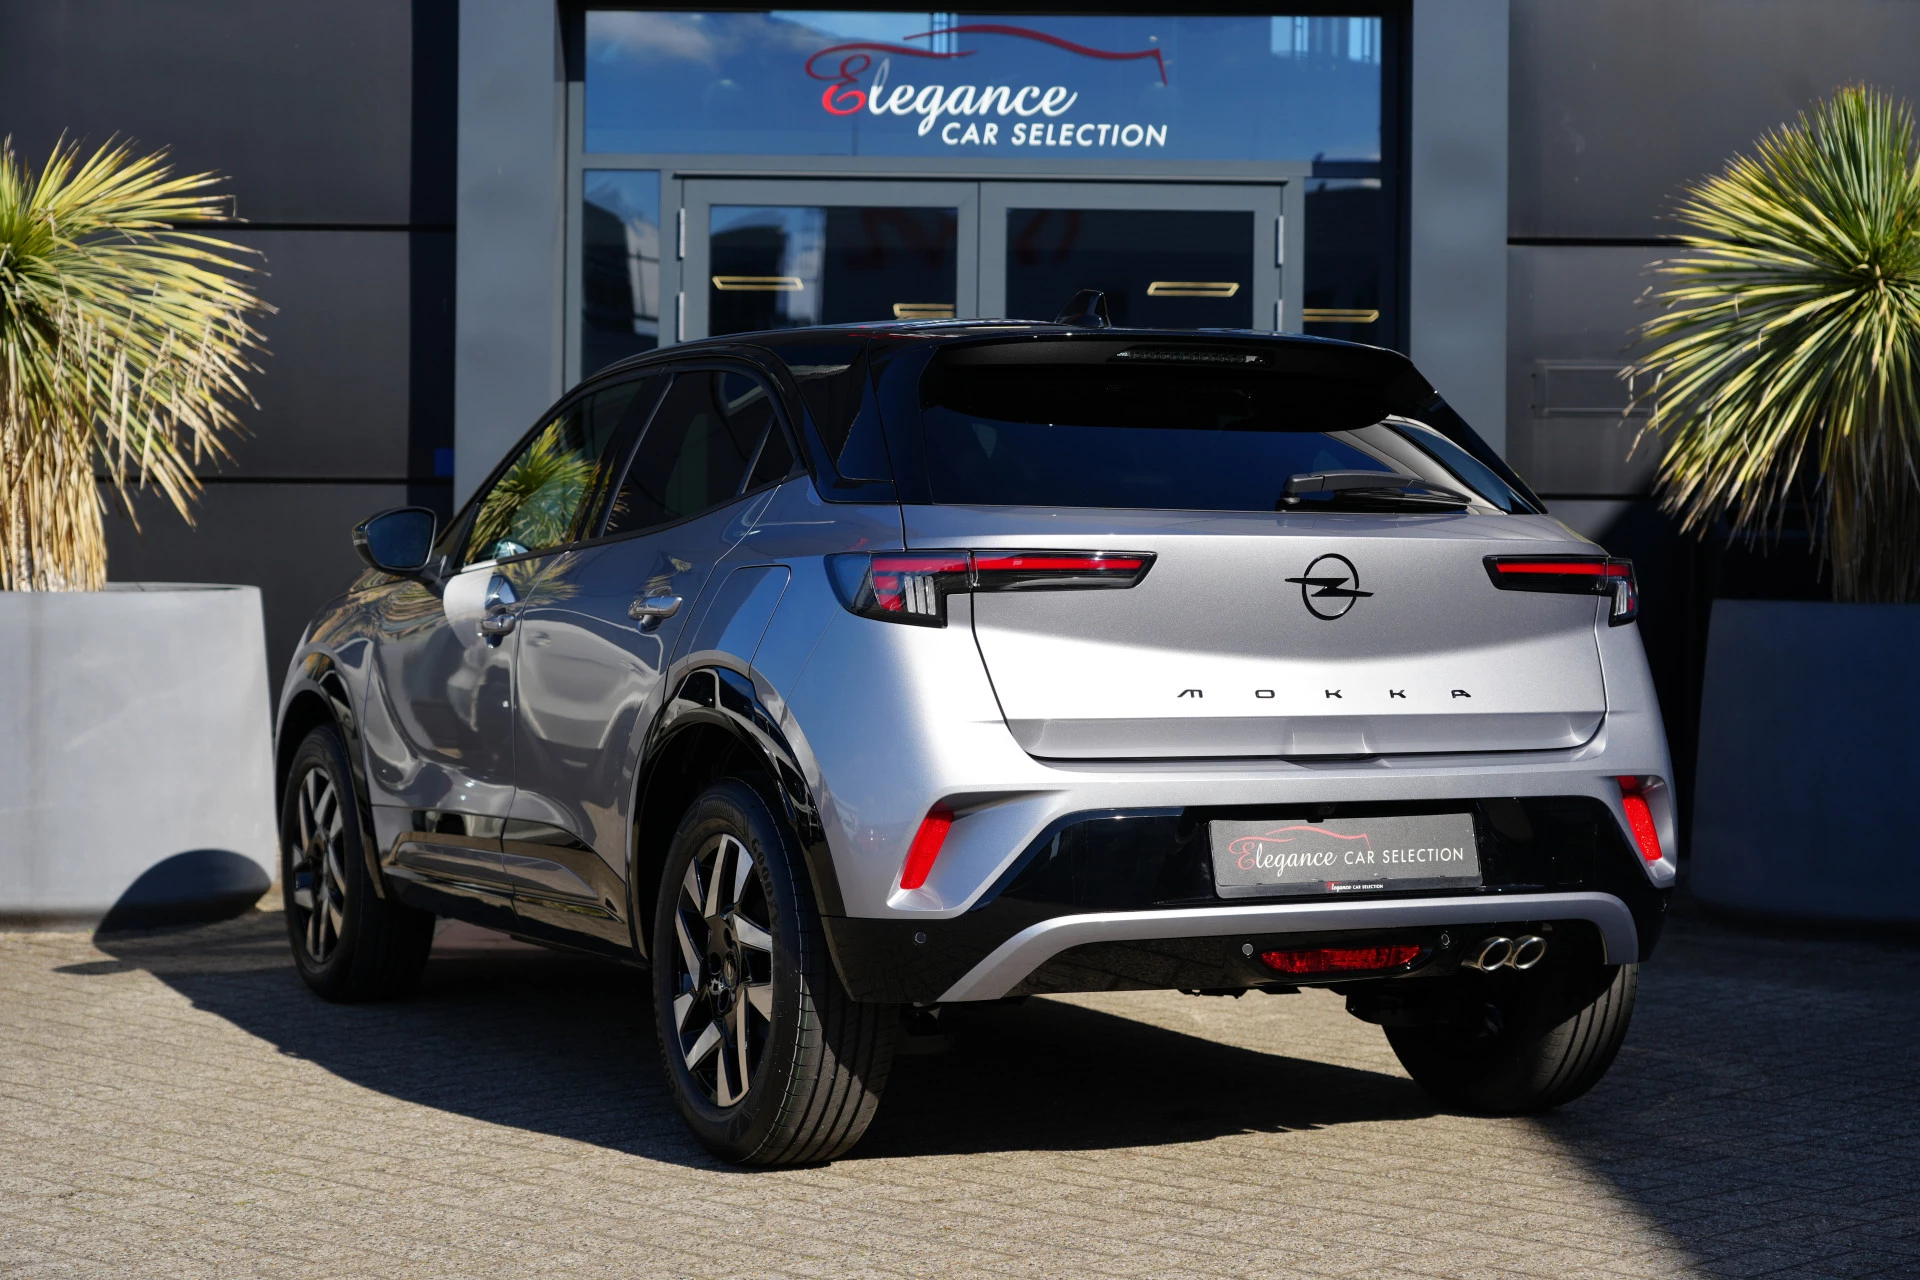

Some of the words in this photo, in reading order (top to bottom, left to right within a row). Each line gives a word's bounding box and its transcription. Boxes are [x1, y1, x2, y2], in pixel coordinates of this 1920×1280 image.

[806, 46, 1078, 136] Elegance
[941, 122, 999, 146] CAR
[1011, 123, 1168, 147] SELECTION
[1177, 688, 1471, 699] MOKKA
[1229, 837, 1337, 877] Elegance
[1344, 851, 1375, 865] CAR
[1382, 847, 1464, 864] SELECTION
